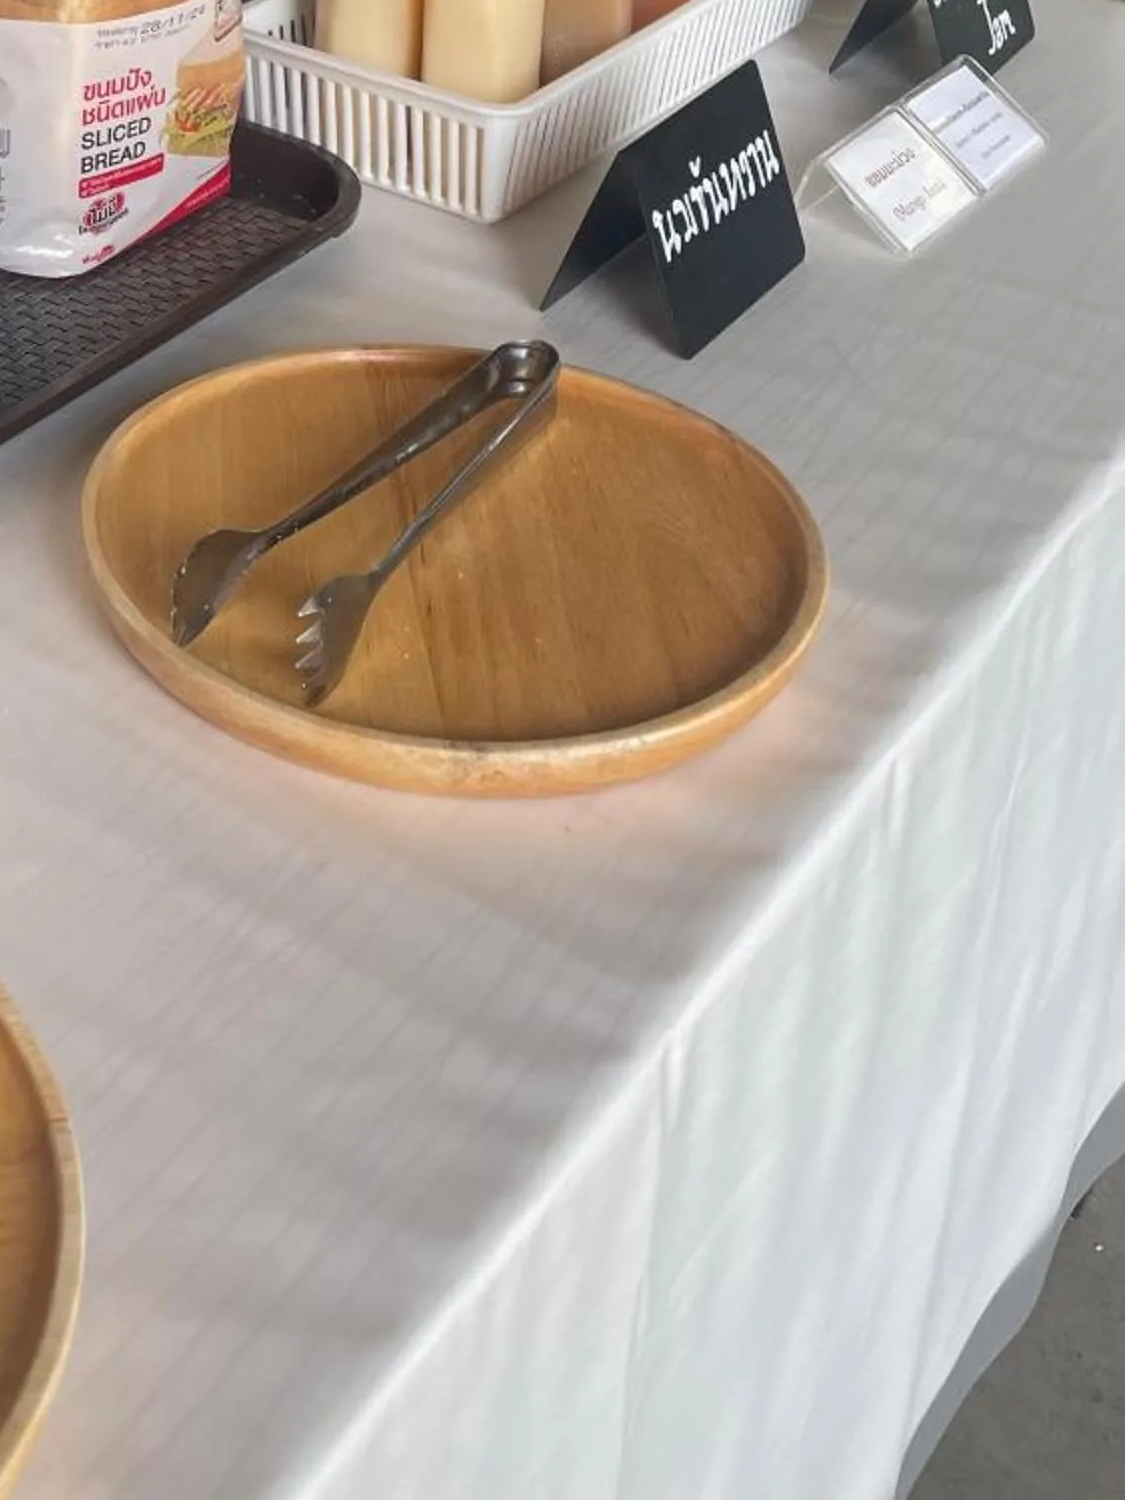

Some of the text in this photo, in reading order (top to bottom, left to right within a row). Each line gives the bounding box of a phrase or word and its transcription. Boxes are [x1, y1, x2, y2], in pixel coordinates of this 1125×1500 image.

[83, 67, 152, 101] ขนมปัง
[82, 84, 166, 126] ชนิดแผ่น
[81, 116, 152, 150] SLICED
[81, 141, 146, 174] BREAD
[652, 129, 780, 263] นมข้นหวาน
